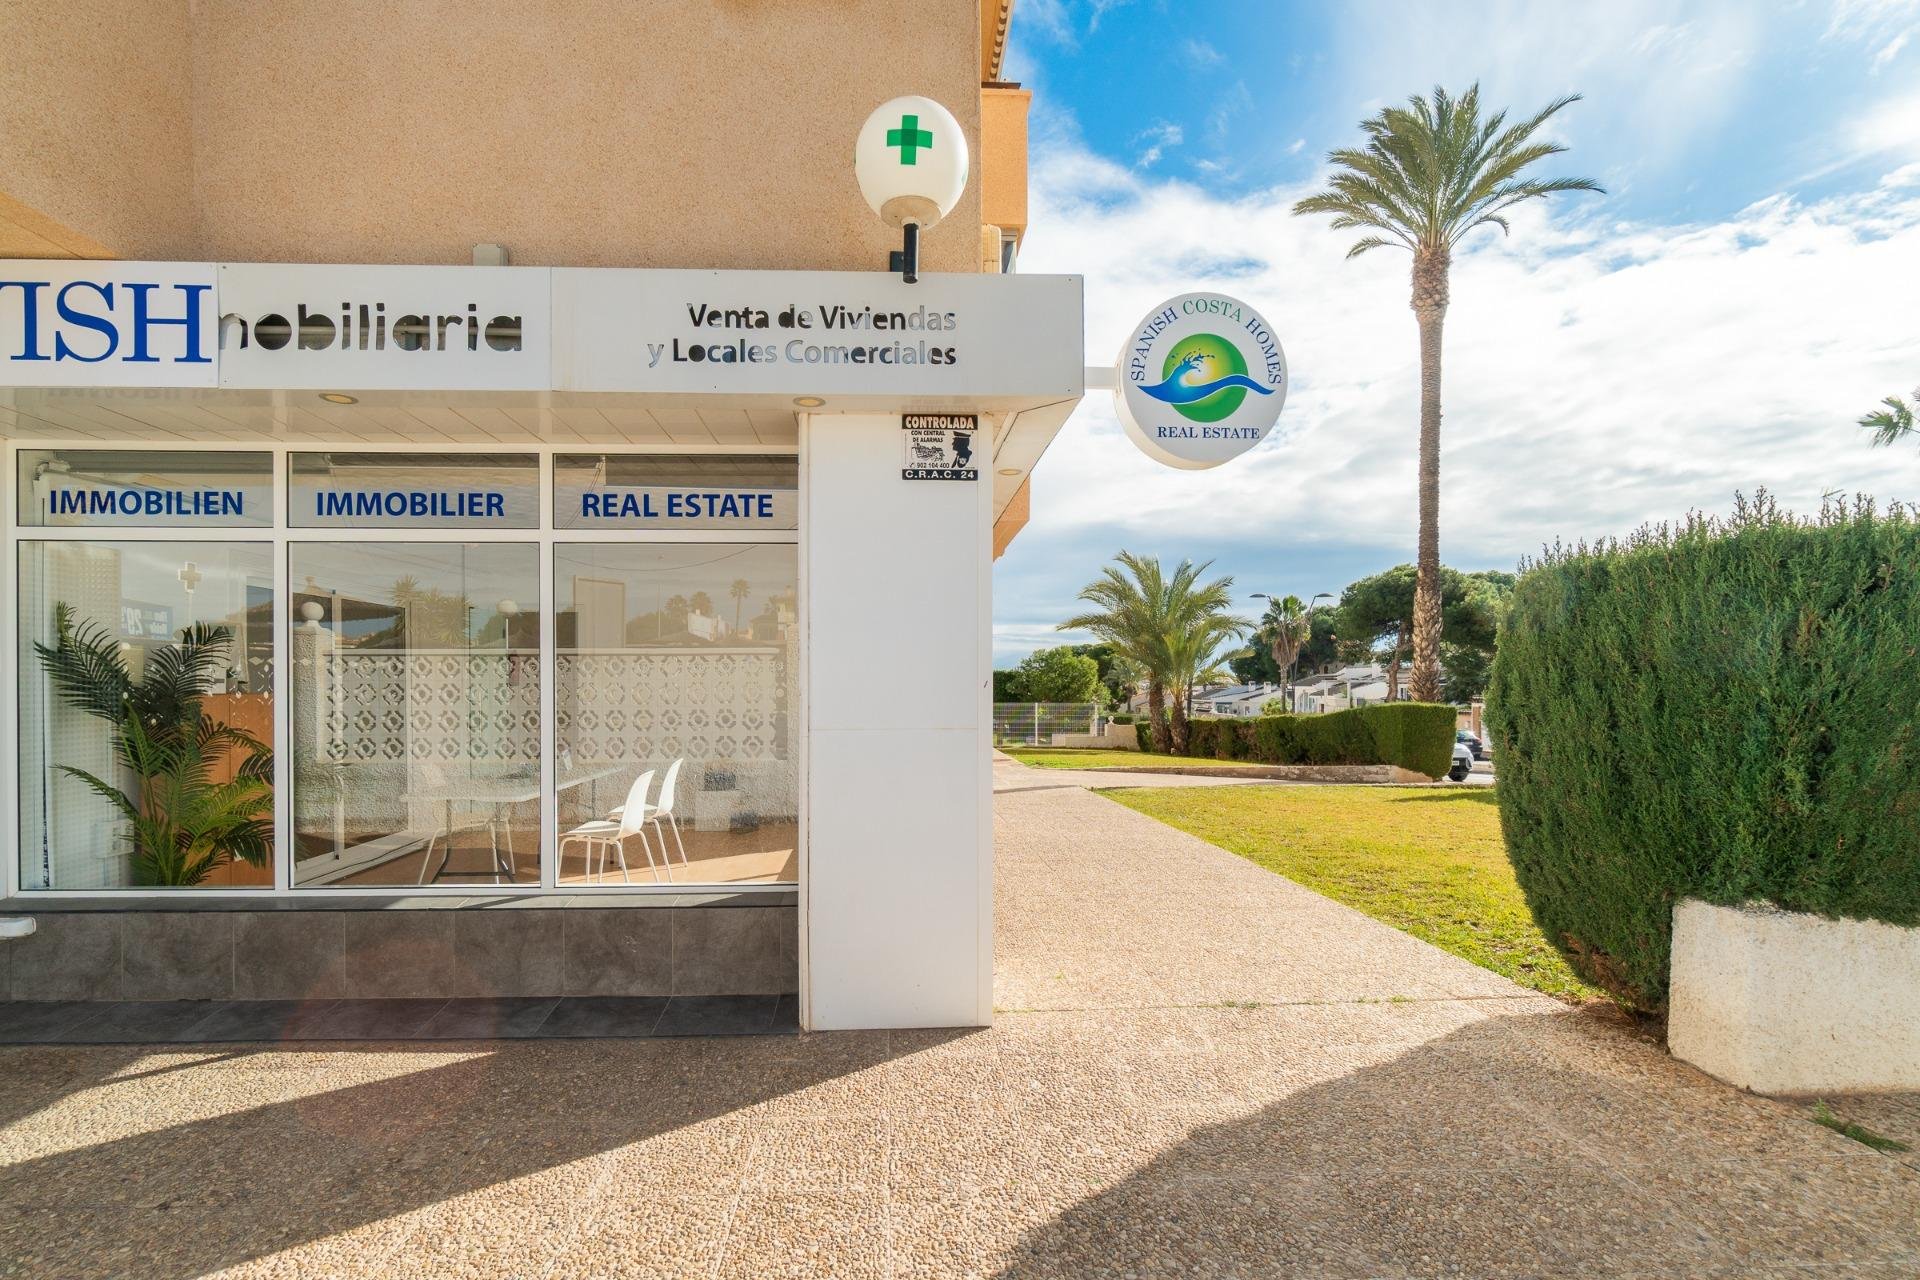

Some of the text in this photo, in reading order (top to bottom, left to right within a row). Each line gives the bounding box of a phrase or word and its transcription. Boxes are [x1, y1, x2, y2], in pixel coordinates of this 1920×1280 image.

[0, 281, 212, 362] ISH
[687, 303, 957, 331] Venta de Viviendas
[647, 338, 957, 369] y Locales Comerciales
[1131, 299, 1282, 384] SPANISH COSTA HOMES
[905, 416, 974, 429] CONTROLADA
[1157, 426, 1260, 439] REAL ESTATE
[905, 470, 974, 479] C.R.A.C. 24
[50, 490, 243, 516] IMMOBILIEN
[316, 492, 504, 517] IMMOBILIER
[582, 493, 774, 518] REAL ESTATE
